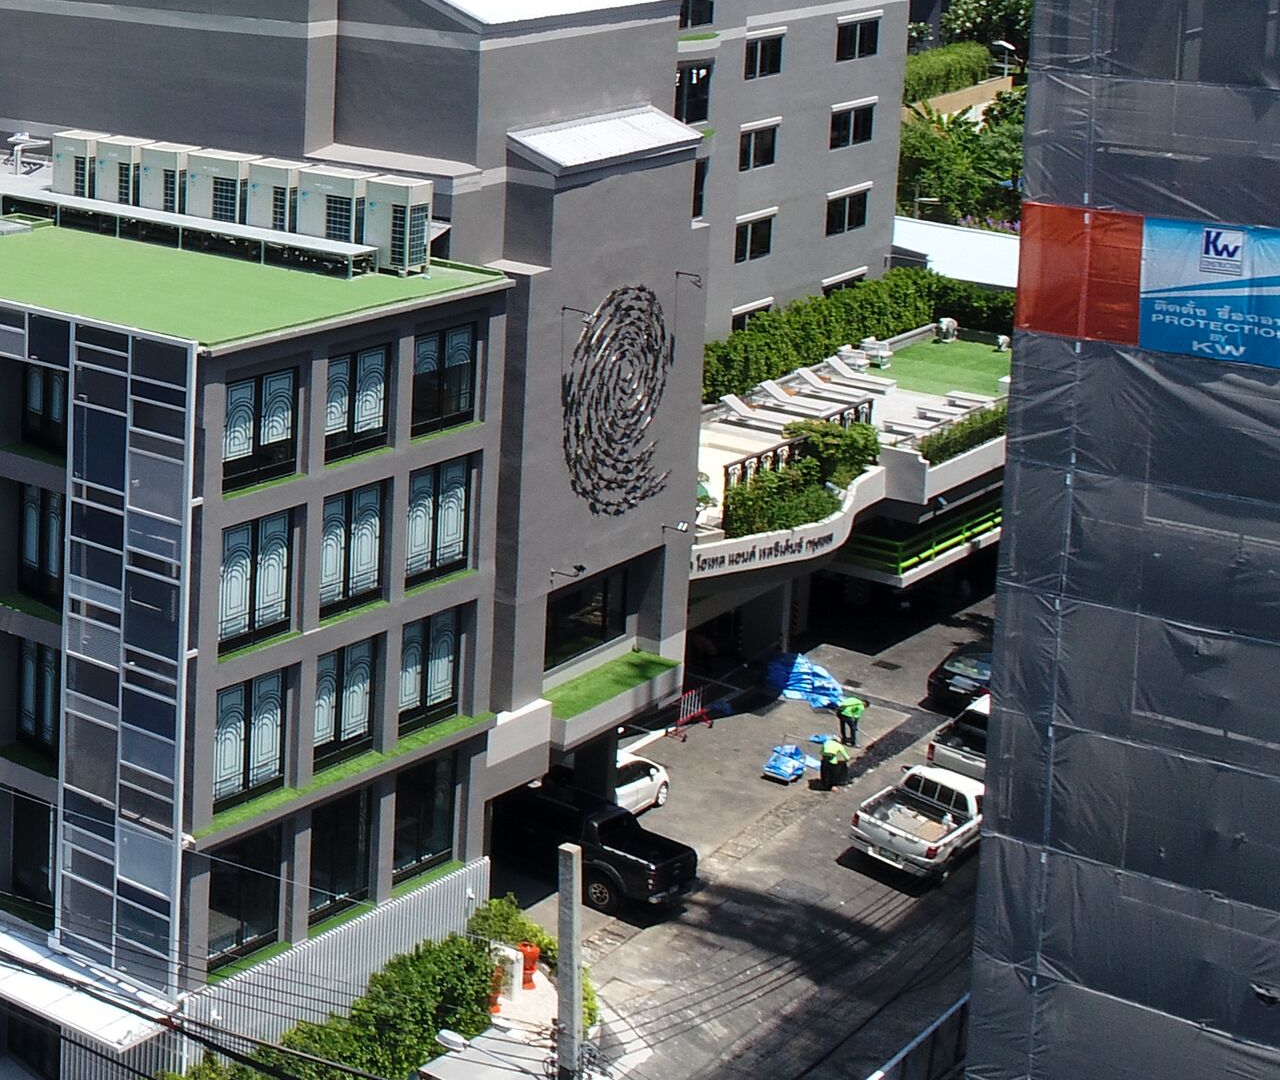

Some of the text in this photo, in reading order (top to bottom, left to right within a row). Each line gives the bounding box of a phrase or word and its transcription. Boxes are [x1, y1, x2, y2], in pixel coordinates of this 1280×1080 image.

[1151, 313, 1280, 339] PROTECTIO
[1209, 333, 1228, 342] BY
[1192, 340, 1247, 357] KW
